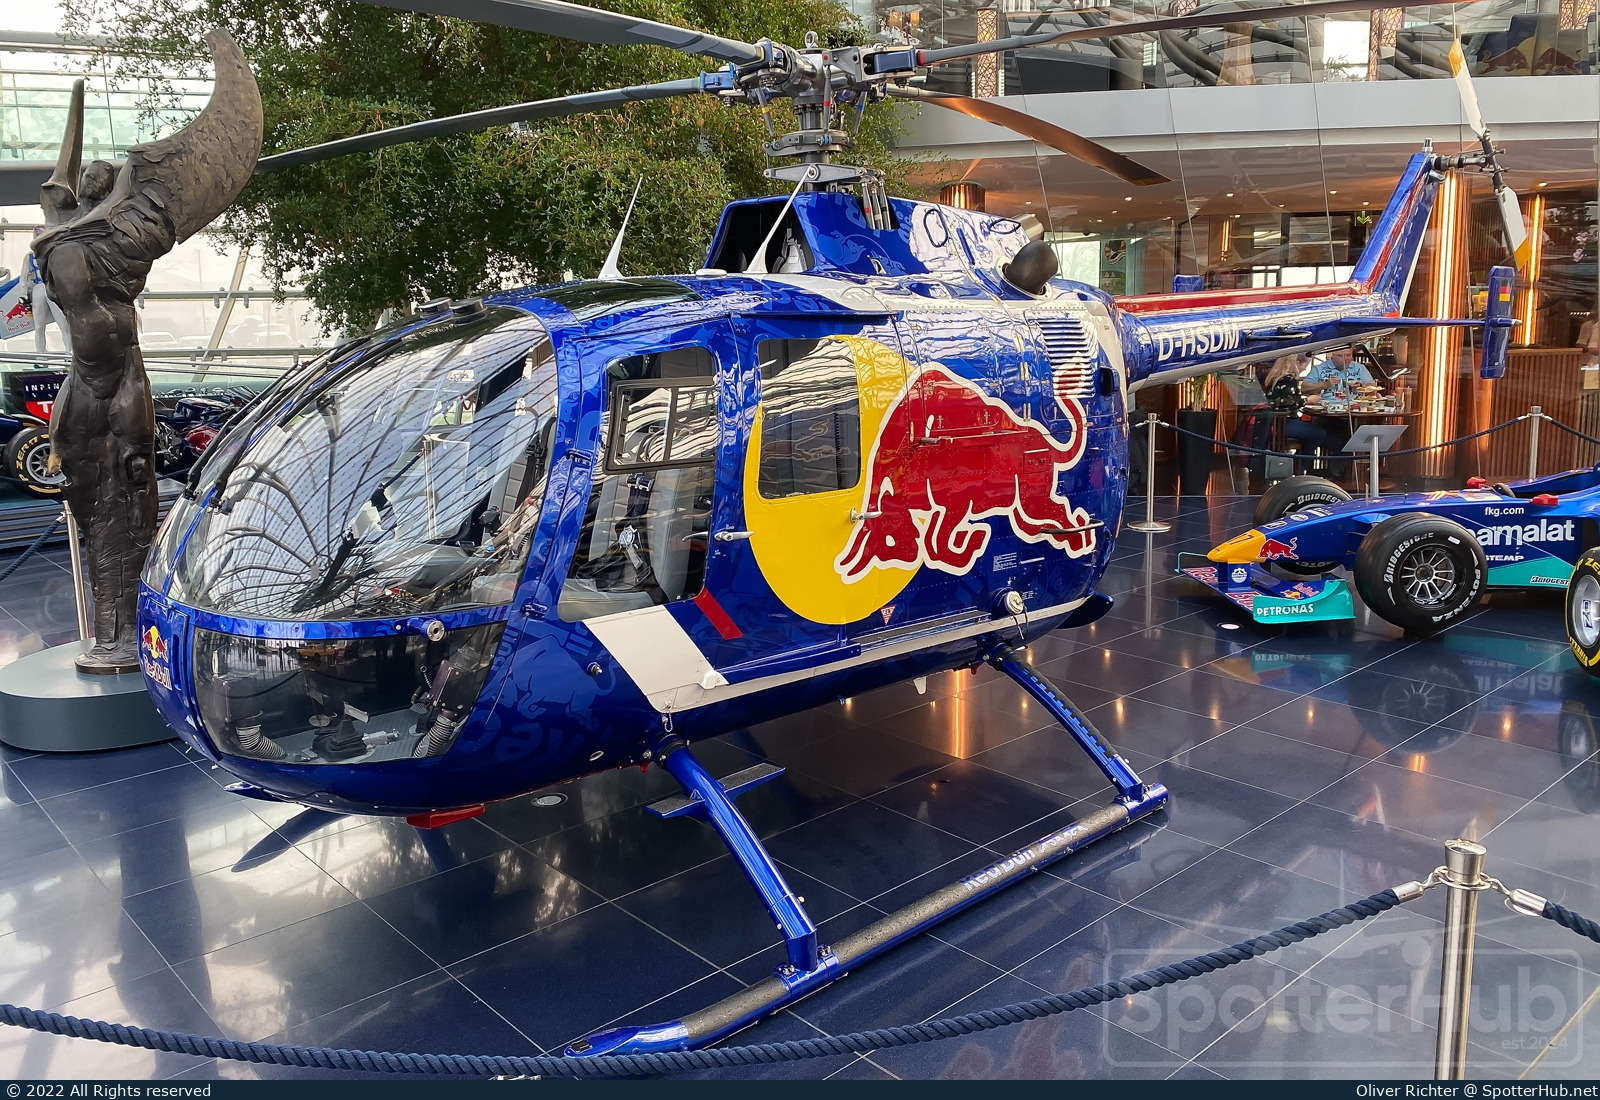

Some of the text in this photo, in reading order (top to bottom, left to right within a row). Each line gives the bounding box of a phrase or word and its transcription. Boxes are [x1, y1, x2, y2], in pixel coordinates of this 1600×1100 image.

[1157, 323, 1241, 361] D-HSDM
[36, 400, 55, 414] T
[16, 436, 38, 470] ZERO
[1484, 506, 1525, 517] fkg.com
[1431, 569, 1481, 622] POTENZA
[1256, 603, 1314, 617] PETRONAS
